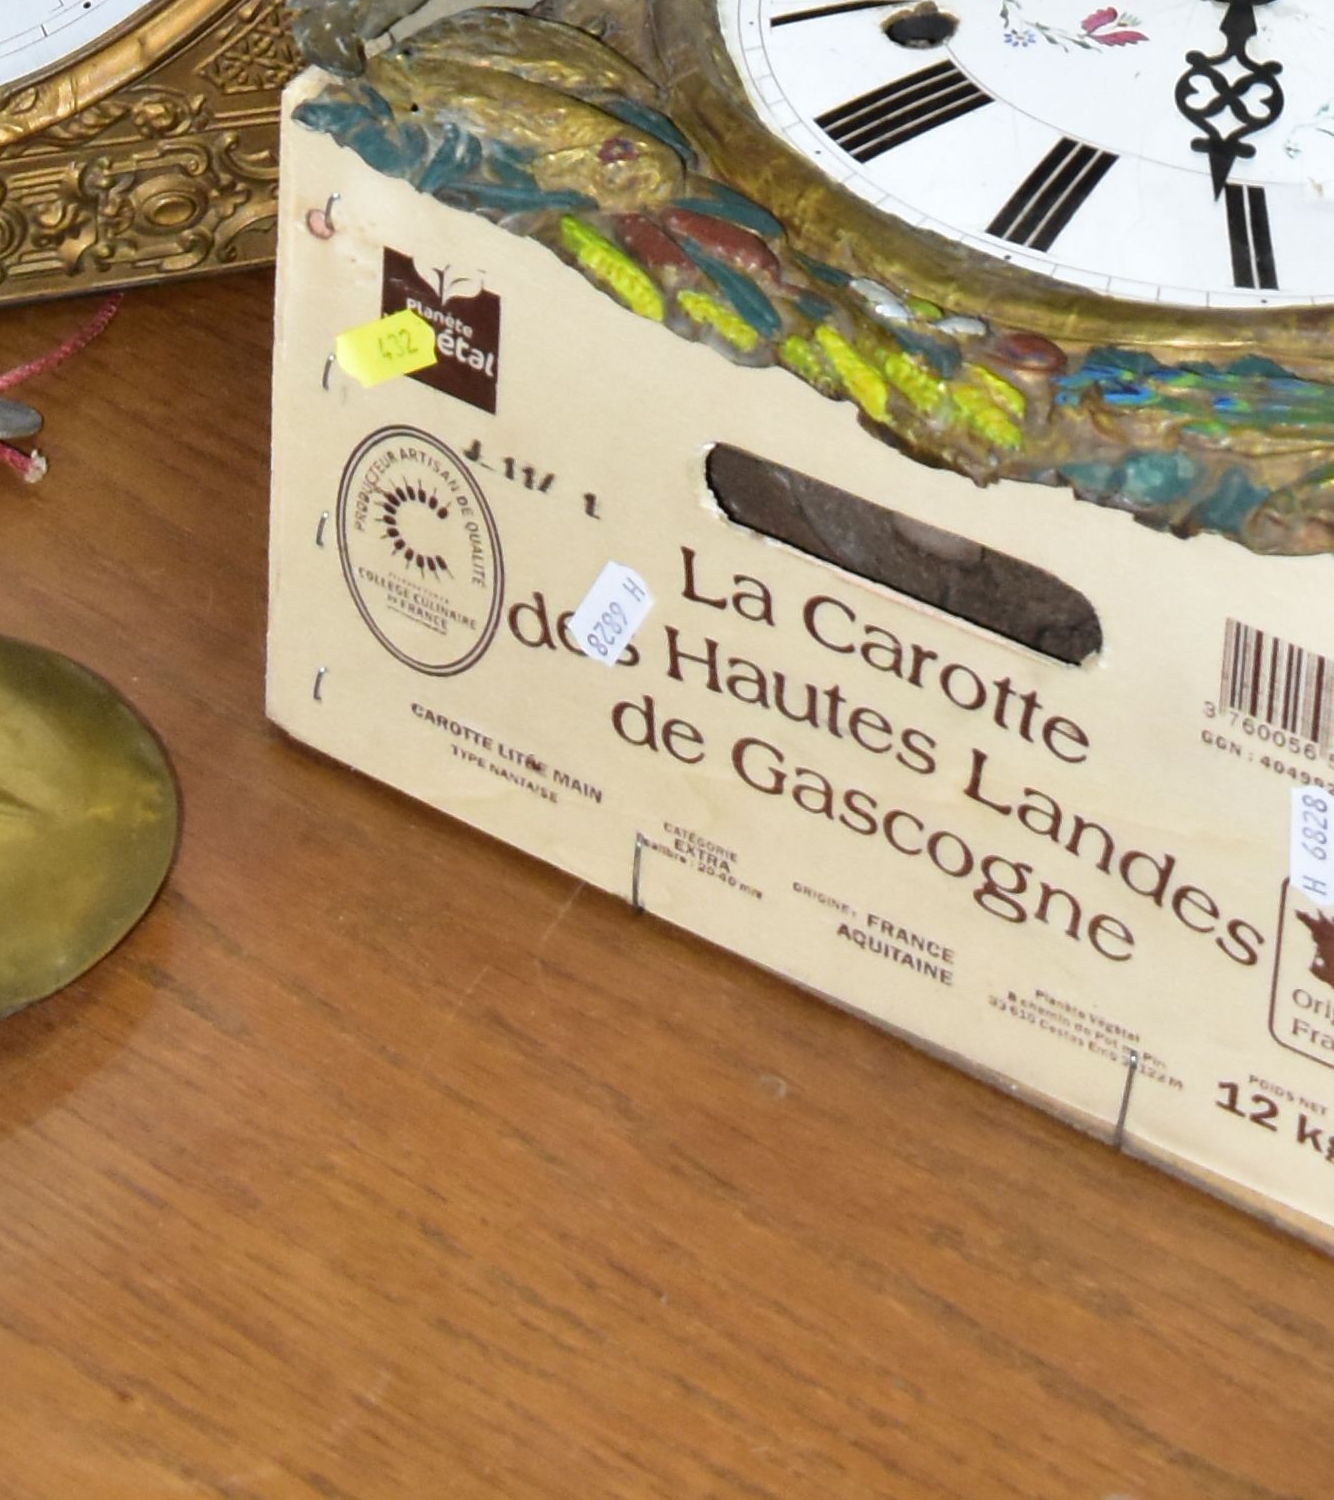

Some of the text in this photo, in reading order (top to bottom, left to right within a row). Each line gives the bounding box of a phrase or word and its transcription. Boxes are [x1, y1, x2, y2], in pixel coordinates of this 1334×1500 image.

[985, 136, 1120, 255] III
[406, 297, 473, 339] Planète
[377, 329, 418, 361] 432
[436, 329, 494, 377] étal
[399, 446, 460, 493] ARTISAN
[456, 494, 473, 518] DE
[399, 600, 448, 631] FRANCE
[414, 592, 477, 631] CULINAIRE
[586, 576, 646, 656] H 6828
[680, 546, 1090, 763] La Carotte
[411, 702, 493, 750] CAROTTE
[552, 768, 603, 804] MAIN
[1201, 729, 1241, 757] GGN
[1227, 710, 1318, 762] 760056
[450, 743, 559, 804] TYPE NANTAISE
[664, 626, 937, 774] Hautes
[964, 748, 1265, 967] Landes
[611, 694, 1135, 962] de Gascogne
[663, 821, 739, 863] CATÉGORIE
[1302, 794, 1329, 896] H 6828
[674, 839, 731, 874] EXTRA
[837, 922, 954, 986] AQUITAINE
[867, 913, 955, 965] FRANCE
[1215, 1081, 1280, 1133] 12
[1249, 1073, 1296, 1102] POIDS
